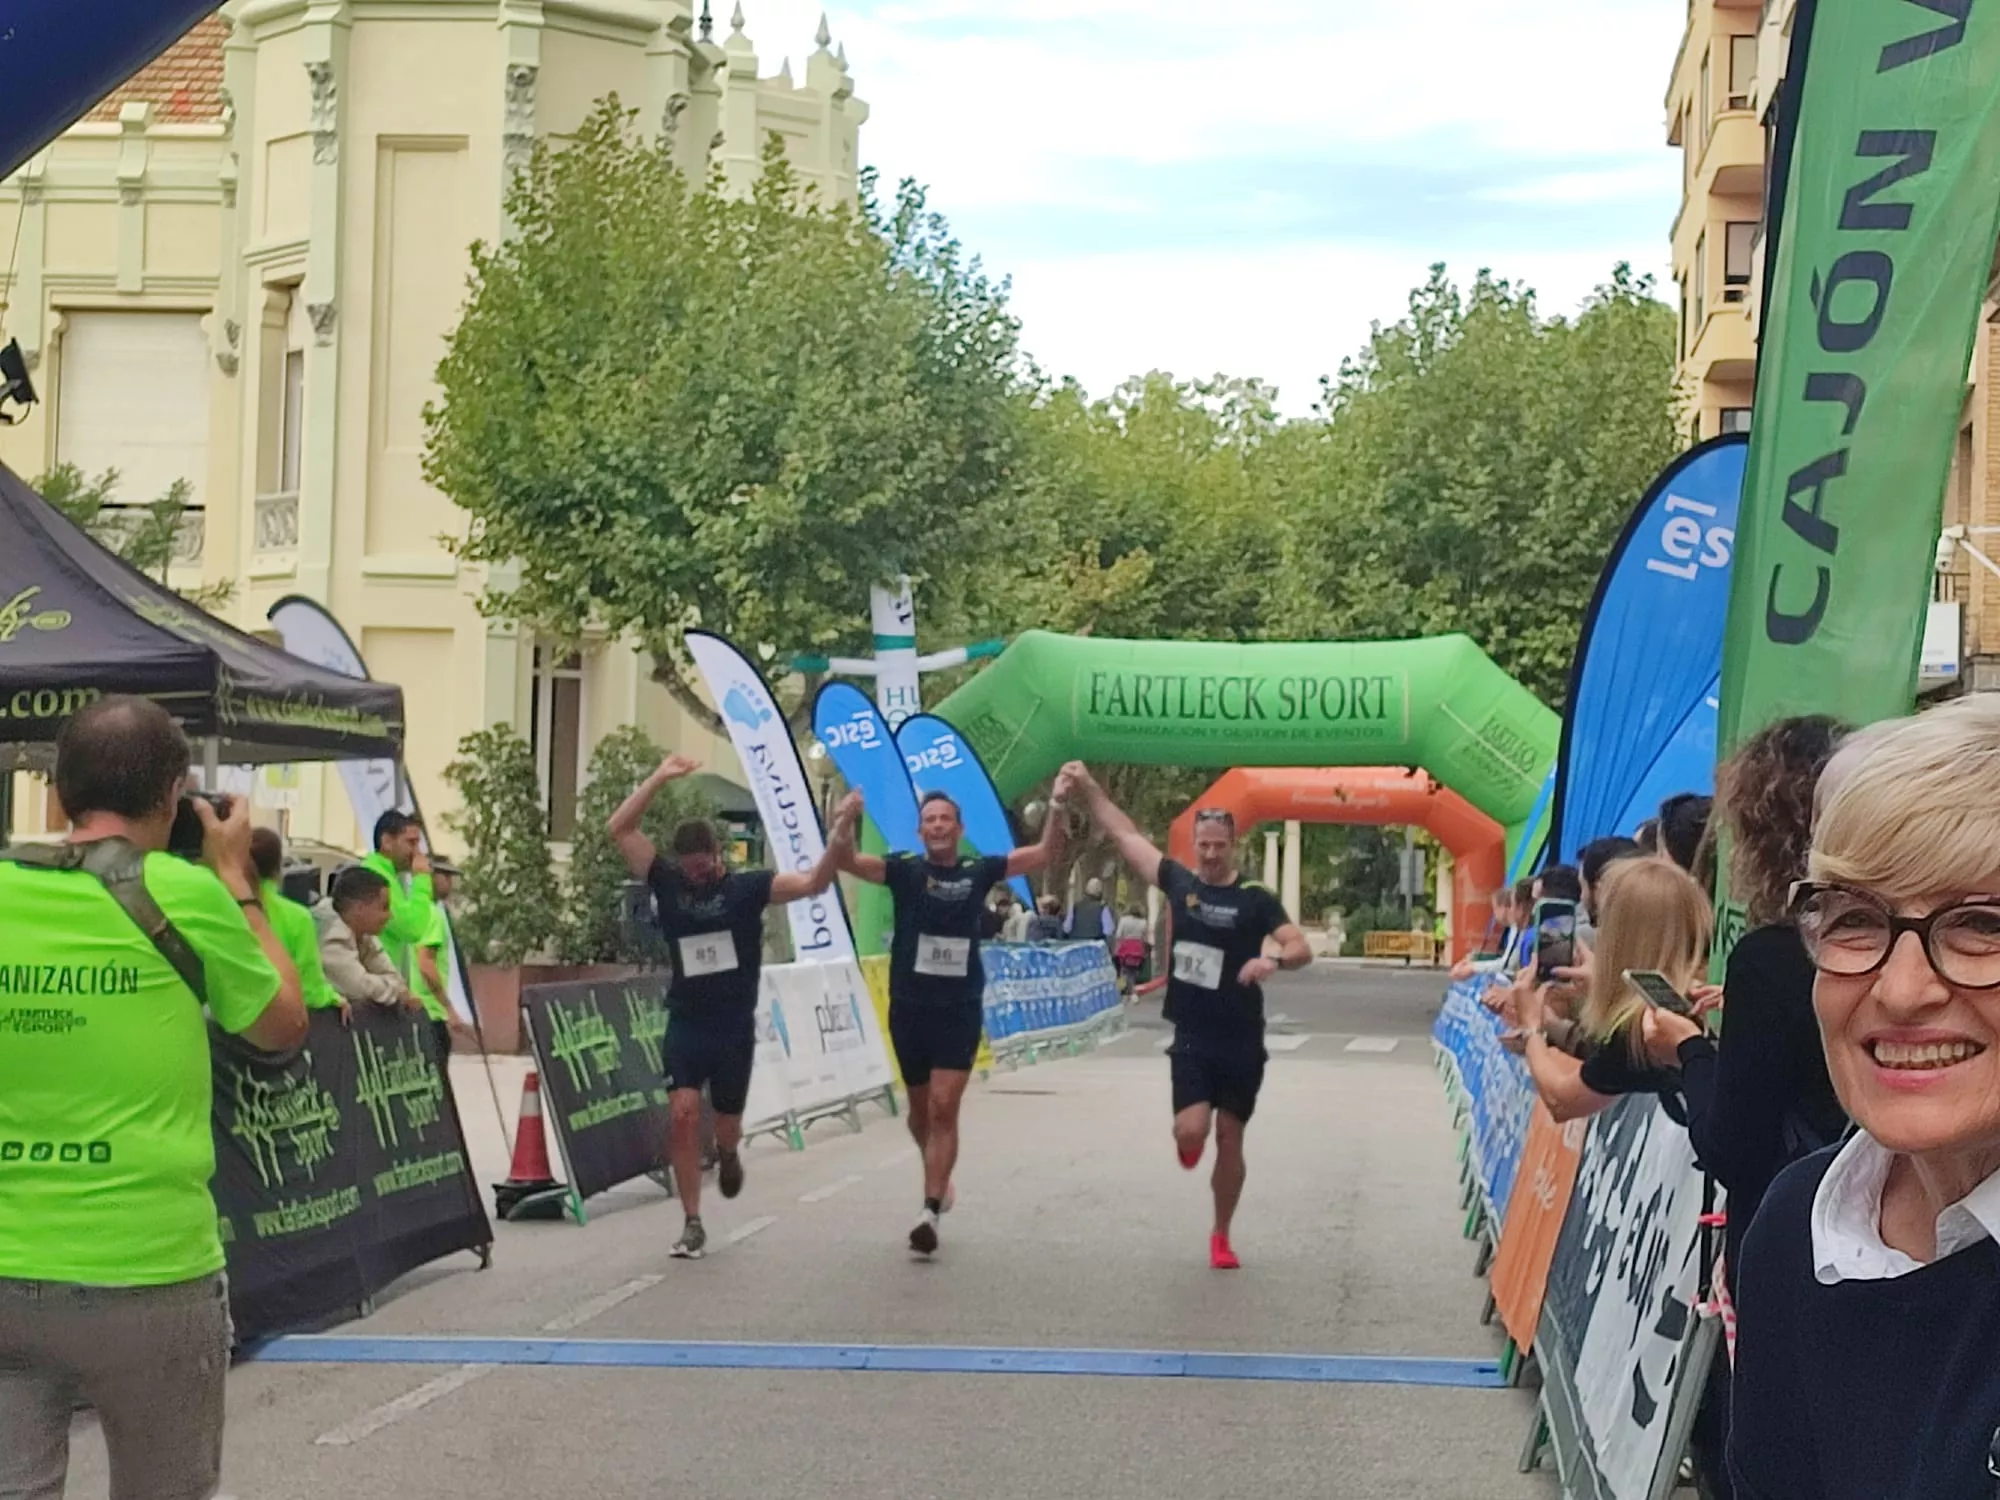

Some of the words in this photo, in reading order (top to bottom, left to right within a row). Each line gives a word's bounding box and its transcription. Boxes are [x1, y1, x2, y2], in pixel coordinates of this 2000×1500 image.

[1766, 129, 1937, 646] CAJÓN
[1088, 671, 1268, 720] FARTLECK
[1277, 675, 1393, 722] SPORT
[0, 958, 138, 995] ANIZACIÓN
